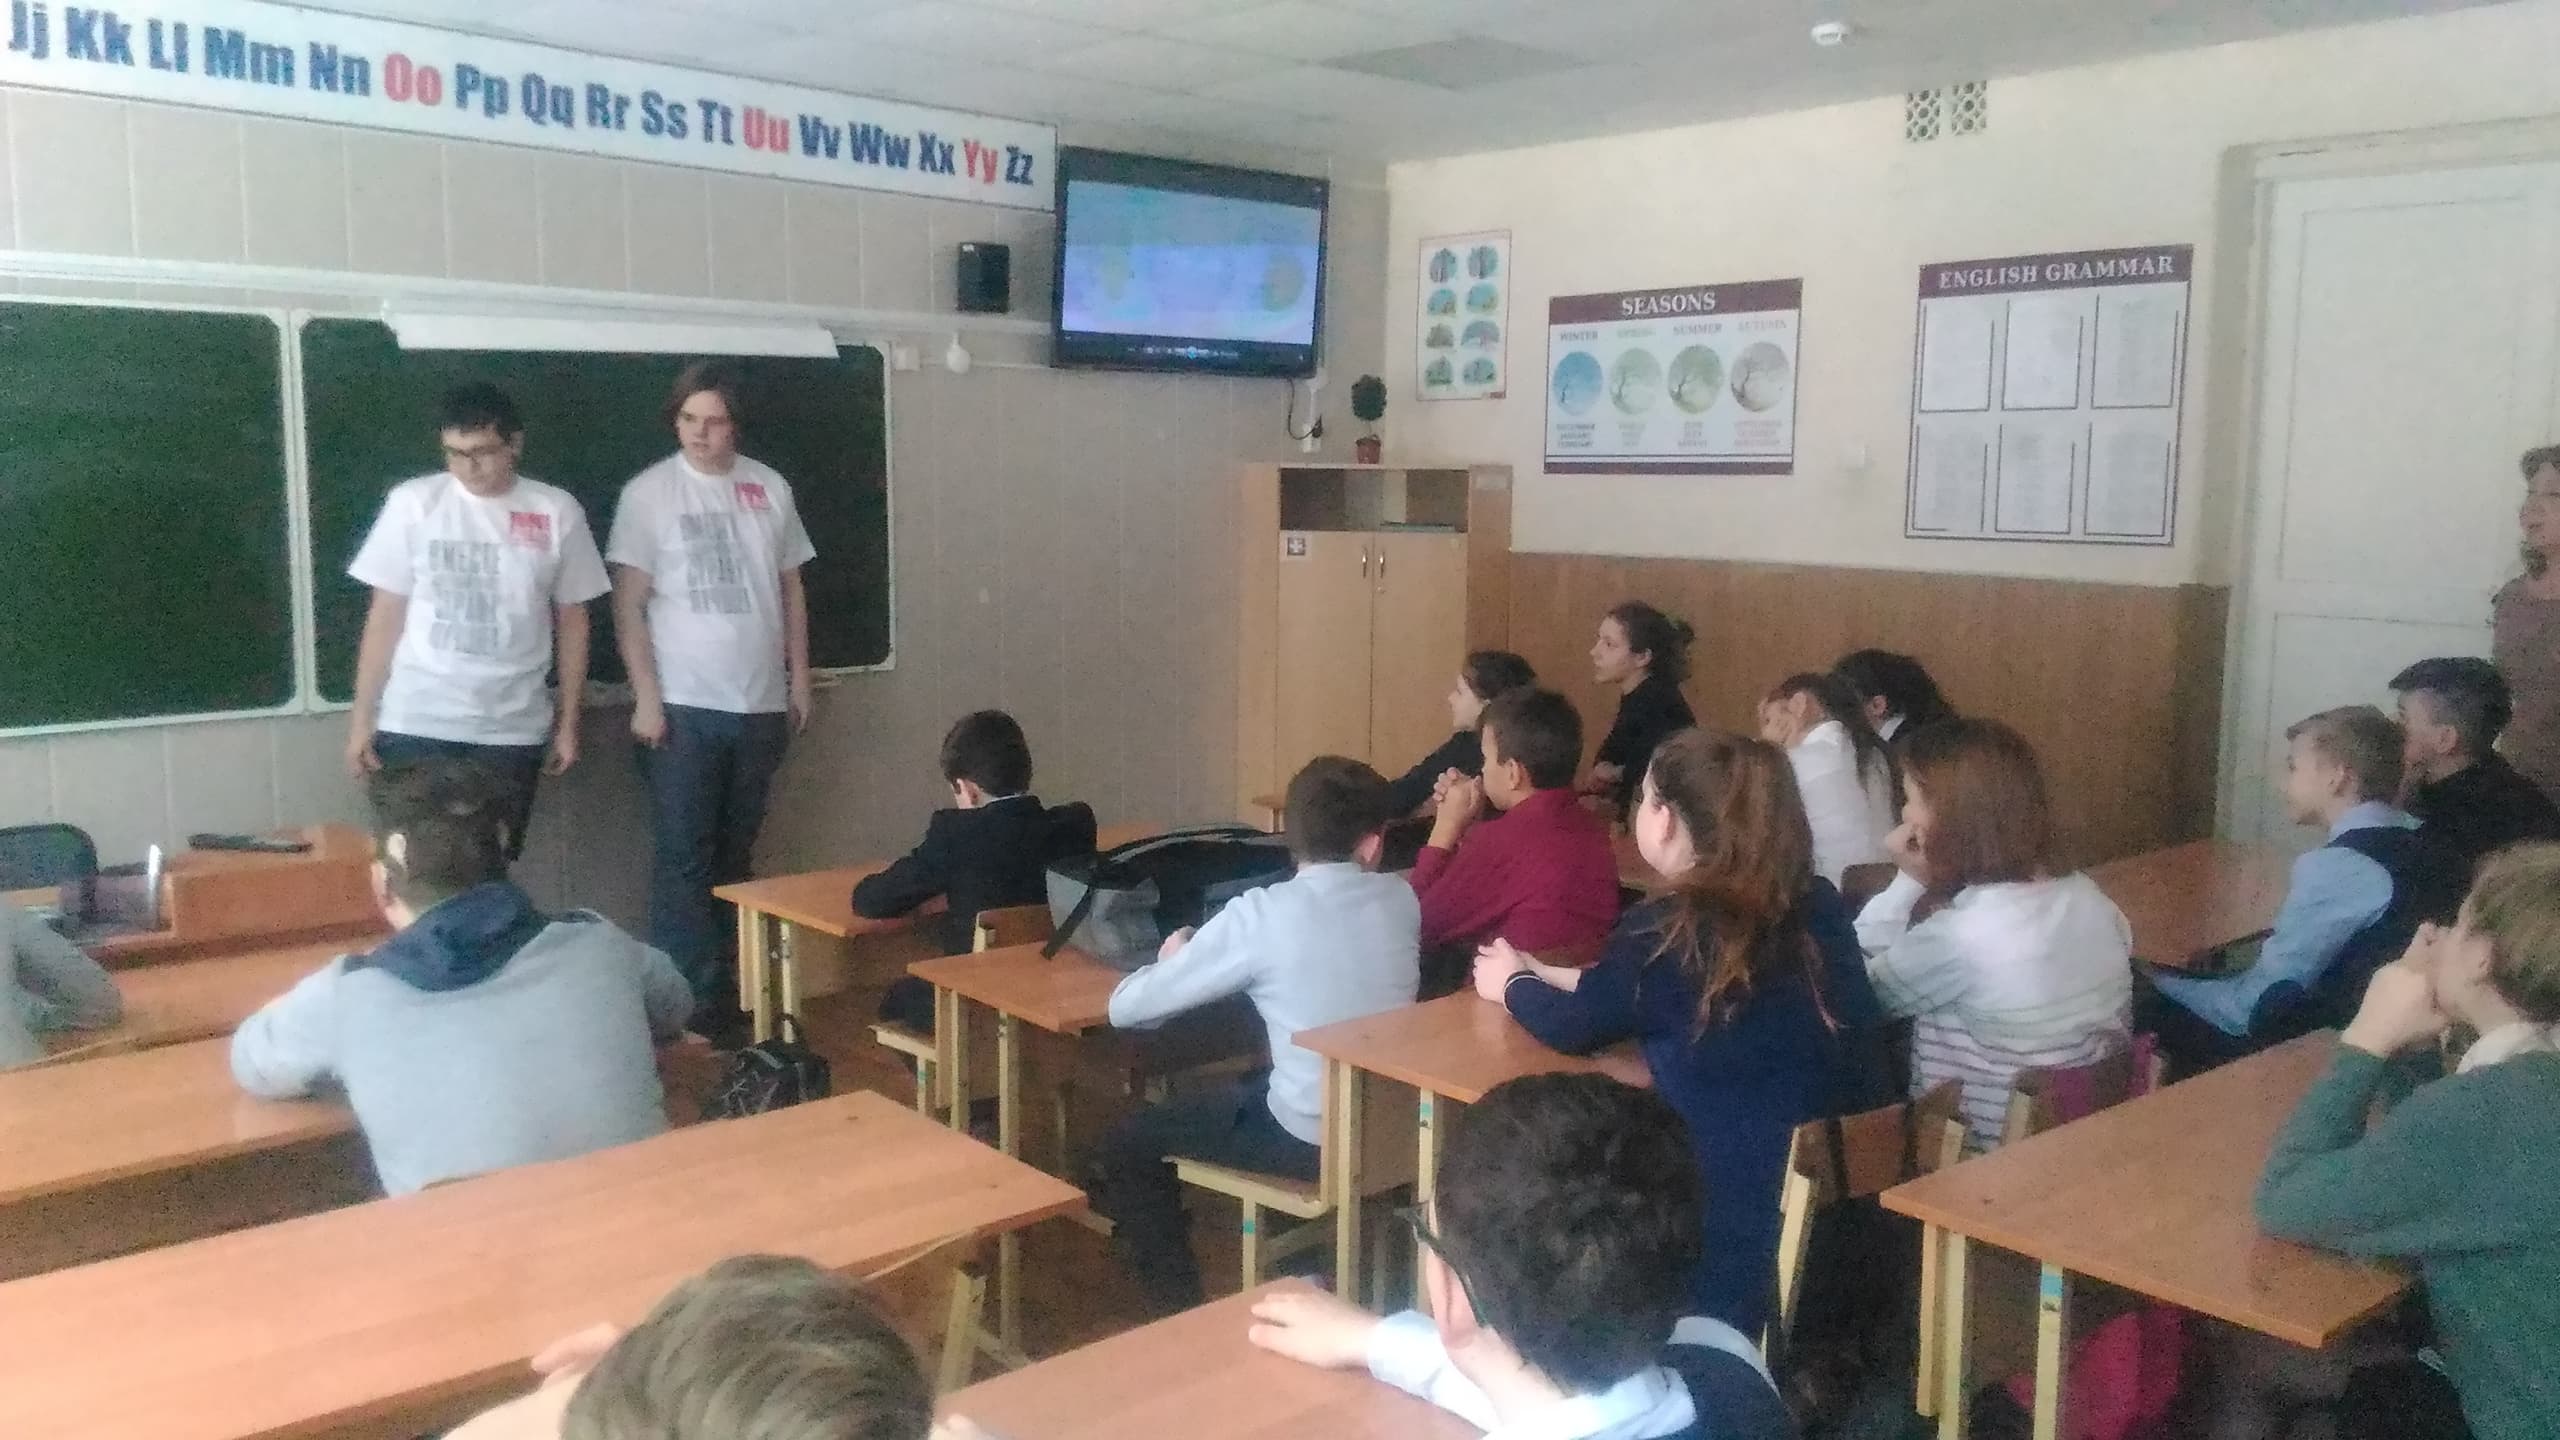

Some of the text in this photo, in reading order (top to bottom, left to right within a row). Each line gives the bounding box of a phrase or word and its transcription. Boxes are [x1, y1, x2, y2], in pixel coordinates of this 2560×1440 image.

[8, 0, 50, 60] Jj
[65, 6, 135, 67] Kk
[203, 26, 296, 88] Mm
[308, 41, 371, 97] Nn
[383, 53, 443, 107] Oo
[454, 63, 510, 119] Pp
[521, 72, 575, 129] Qq
[585, 82, 632, 131] Rr
[640, 90, 689, 140] Ss
[697, 98, 735, 146] Tt
[742, 106, 790, 154] Uu
[798, 113, 842, 160] Vv
[848, 122, 911, 170] Ww
[918, 132, 956, 176] Xx
[962, 139, 999, 185] Yy
[1005, 145, 1034, 187] Zz
[1938, 254, 2175, 290] ENGLISH GRAMMAR
[1621, 291, 1717, 316] SEASONS
[1559, 330, 1599, 342] WINTER
[1672, 322, 1723, 337] SUMMER
